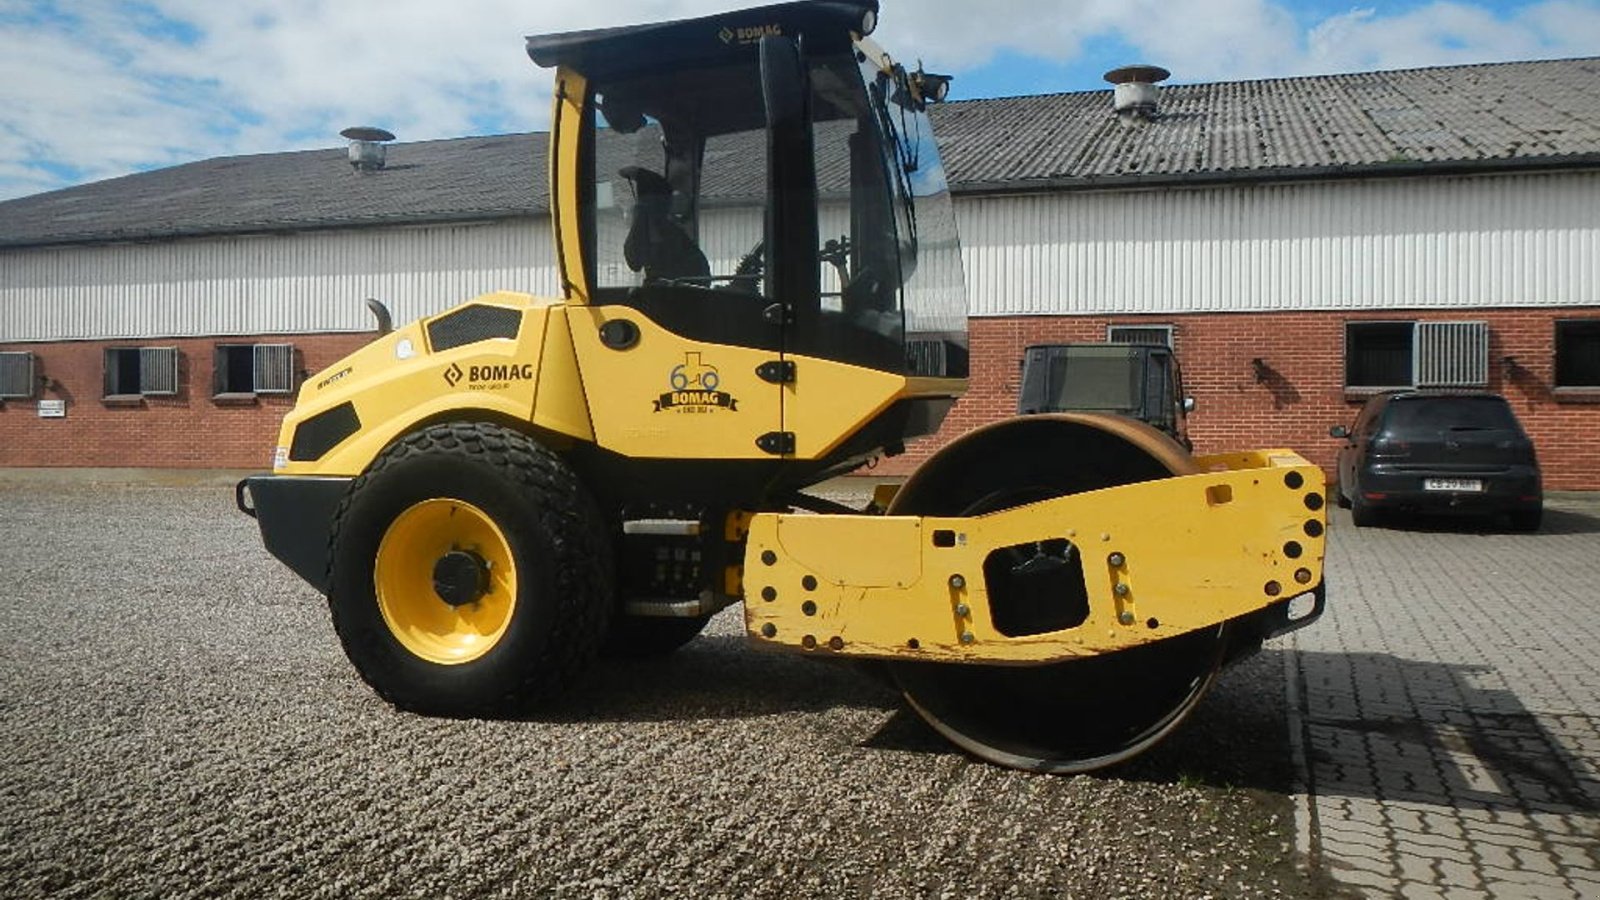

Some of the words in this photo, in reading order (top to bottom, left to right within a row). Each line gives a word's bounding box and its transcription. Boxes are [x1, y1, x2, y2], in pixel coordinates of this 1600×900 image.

[737, 24, 781, 39] BOMAG
[469, 364, 533, 382] BOMAG
[672, 392, 719, 405] BOMAG
